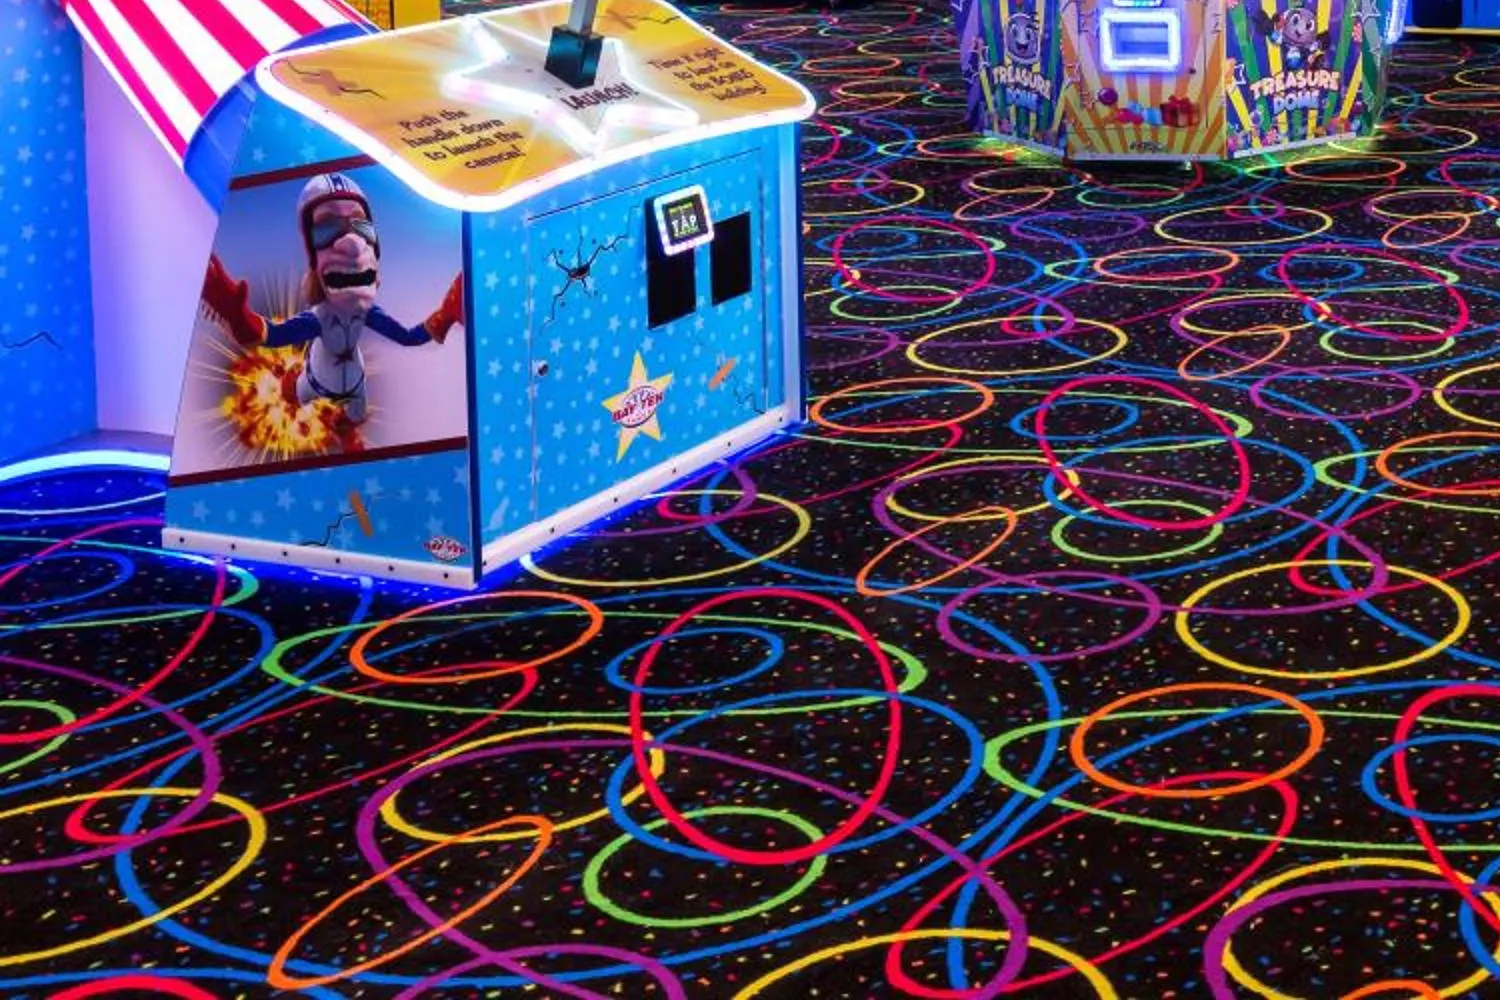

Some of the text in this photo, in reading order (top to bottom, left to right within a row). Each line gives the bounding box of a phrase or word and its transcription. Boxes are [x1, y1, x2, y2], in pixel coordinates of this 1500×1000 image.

[992, 65, 1052, 97] TREASURE
[1249, 68, 1341, 101] TREASURE
[561, 83, 640, 111] LAUNCH!
[1004, 87, 1039, 114] DOME
[1272, 89, 1320, 115] DOME
[399, 108, 470, 132] Push the
[402, 117, 505, 149] handle down
[423, 128, 524, 162] to launch the
[463, 144, 527, 170] cannon!
[671, 213, 700, 238] TAP
